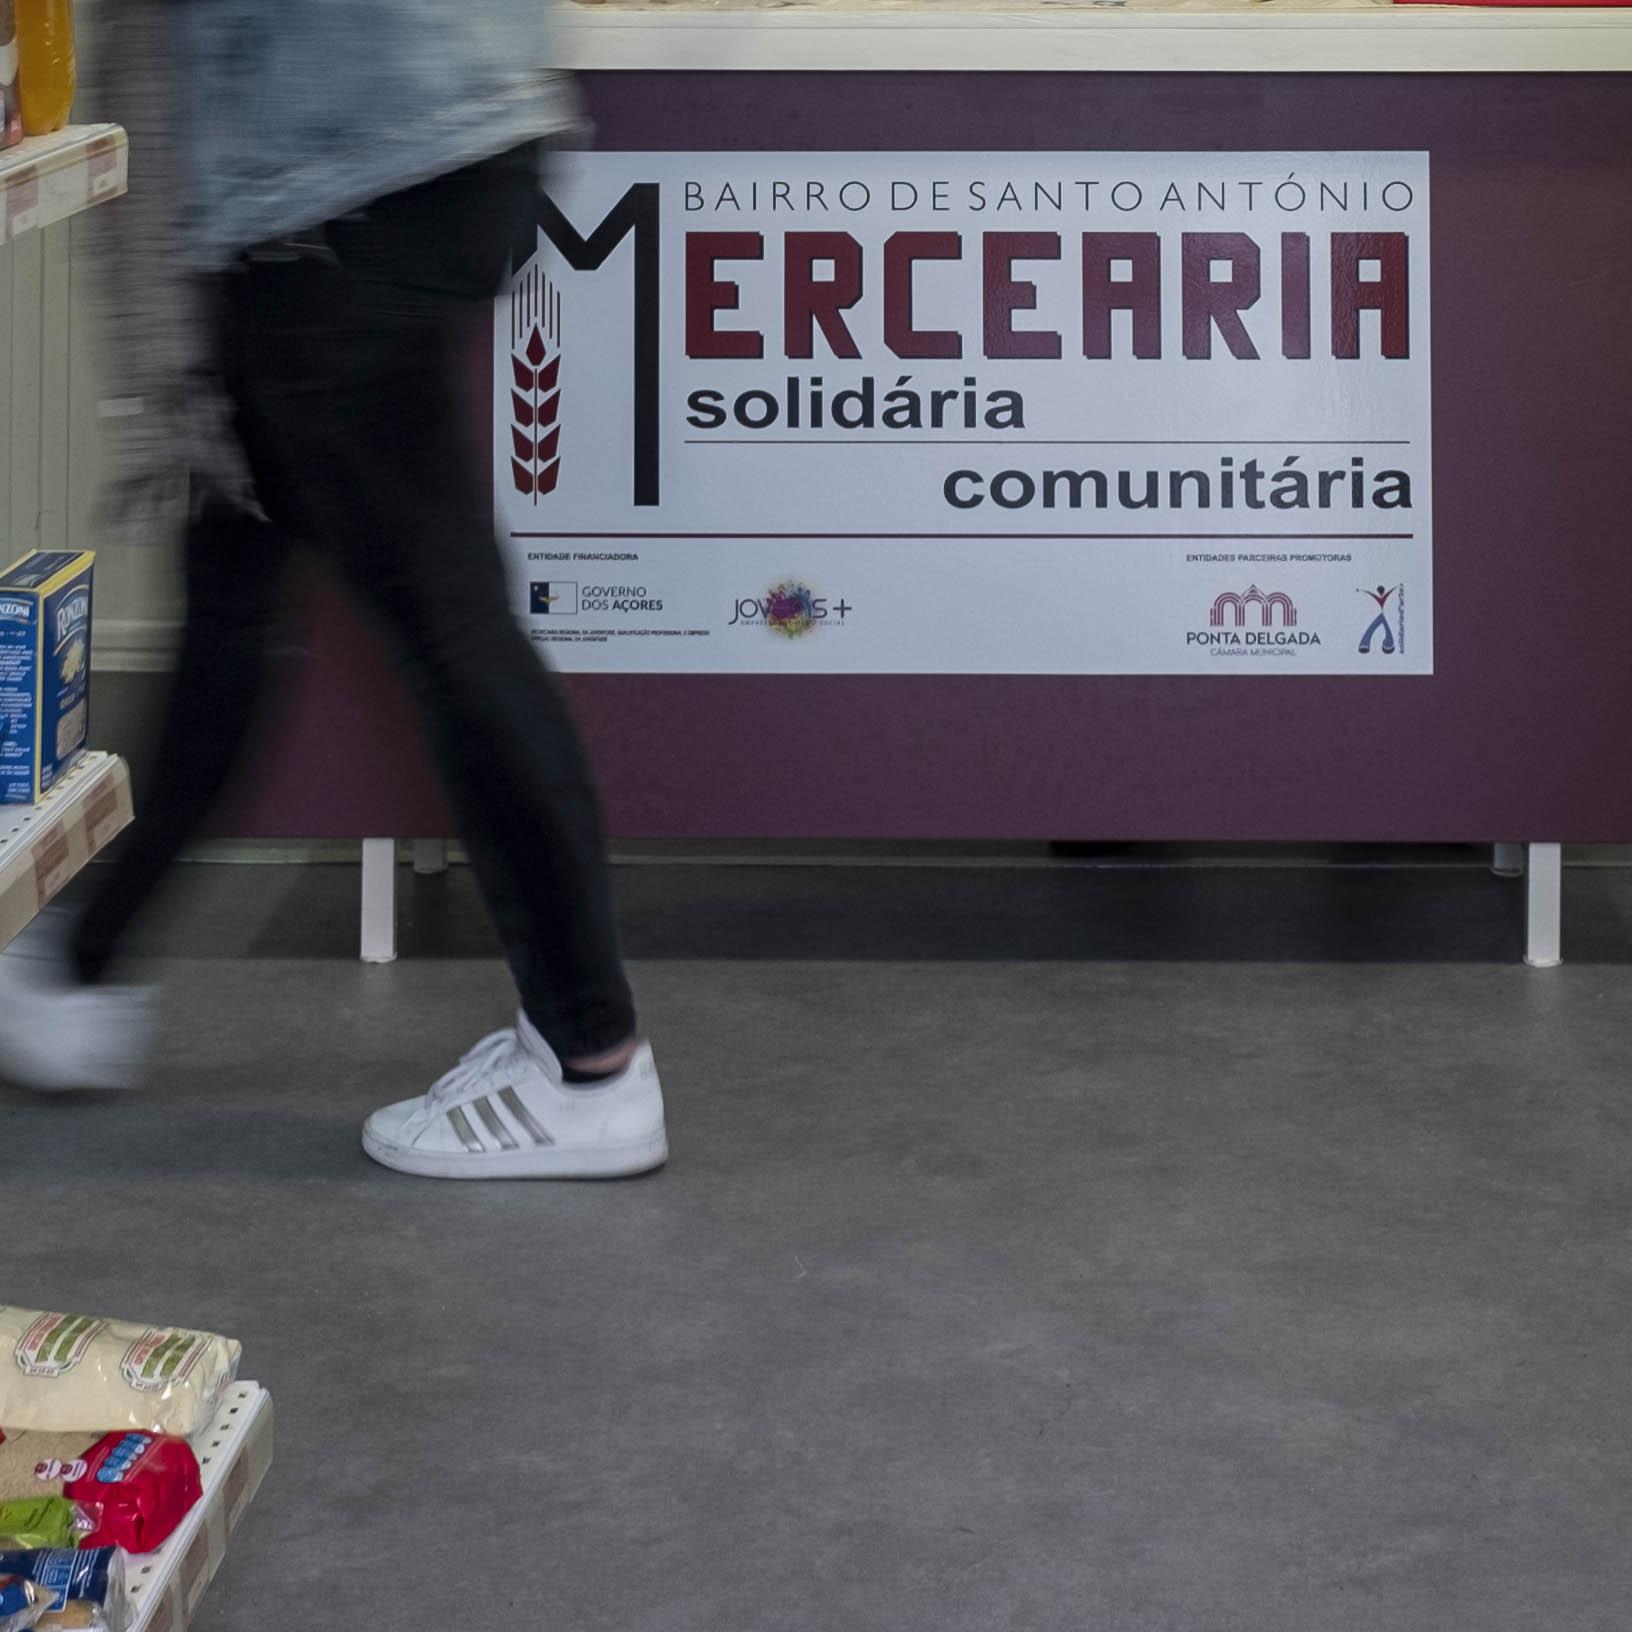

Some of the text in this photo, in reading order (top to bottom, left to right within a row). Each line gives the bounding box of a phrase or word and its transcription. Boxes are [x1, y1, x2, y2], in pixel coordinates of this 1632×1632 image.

[684, 171, 1414, 212] BAIRRO DE SANTO ANTÓNIO
[684, 376, 1027, 430] solidária
[942, 455, 1413, 510] comunitária
[527, 552, 639, 562] ENTIDADE FINANCIADORA
[1186, 553, 1352, 562] ENTIDADES PARCEIRAS PROMOTORAS
[581, 585, 647, 598] GOVERNO
[581, 599, 664, 613] DOS AÇORES
[1186, 631, 1321, 646] PONTA DELGADA
